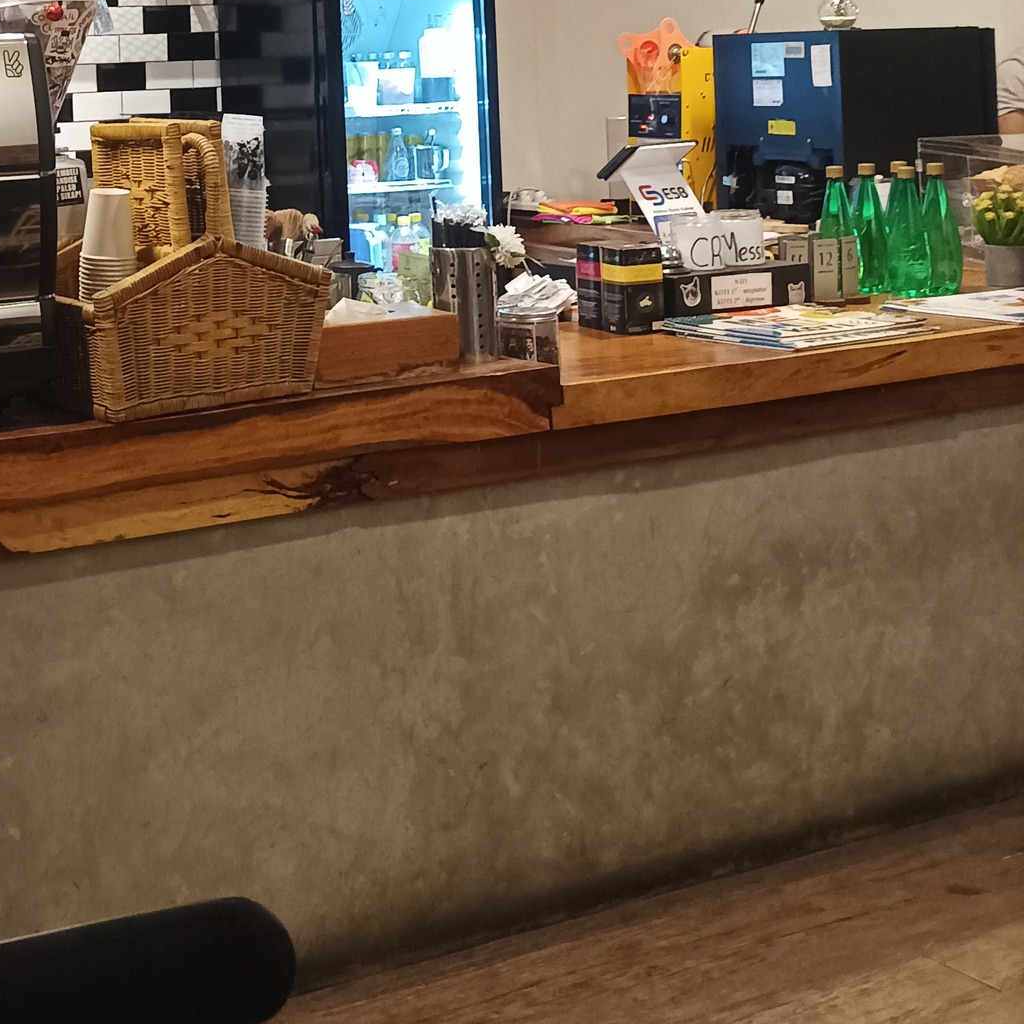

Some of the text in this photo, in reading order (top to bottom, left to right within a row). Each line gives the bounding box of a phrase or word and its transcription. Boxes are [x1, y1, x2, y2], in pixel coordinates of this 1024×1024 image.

[661, 186, 689, 200] ESB
[818, 251, 833, 266] 12
[846, 248, 853, 262] 6
